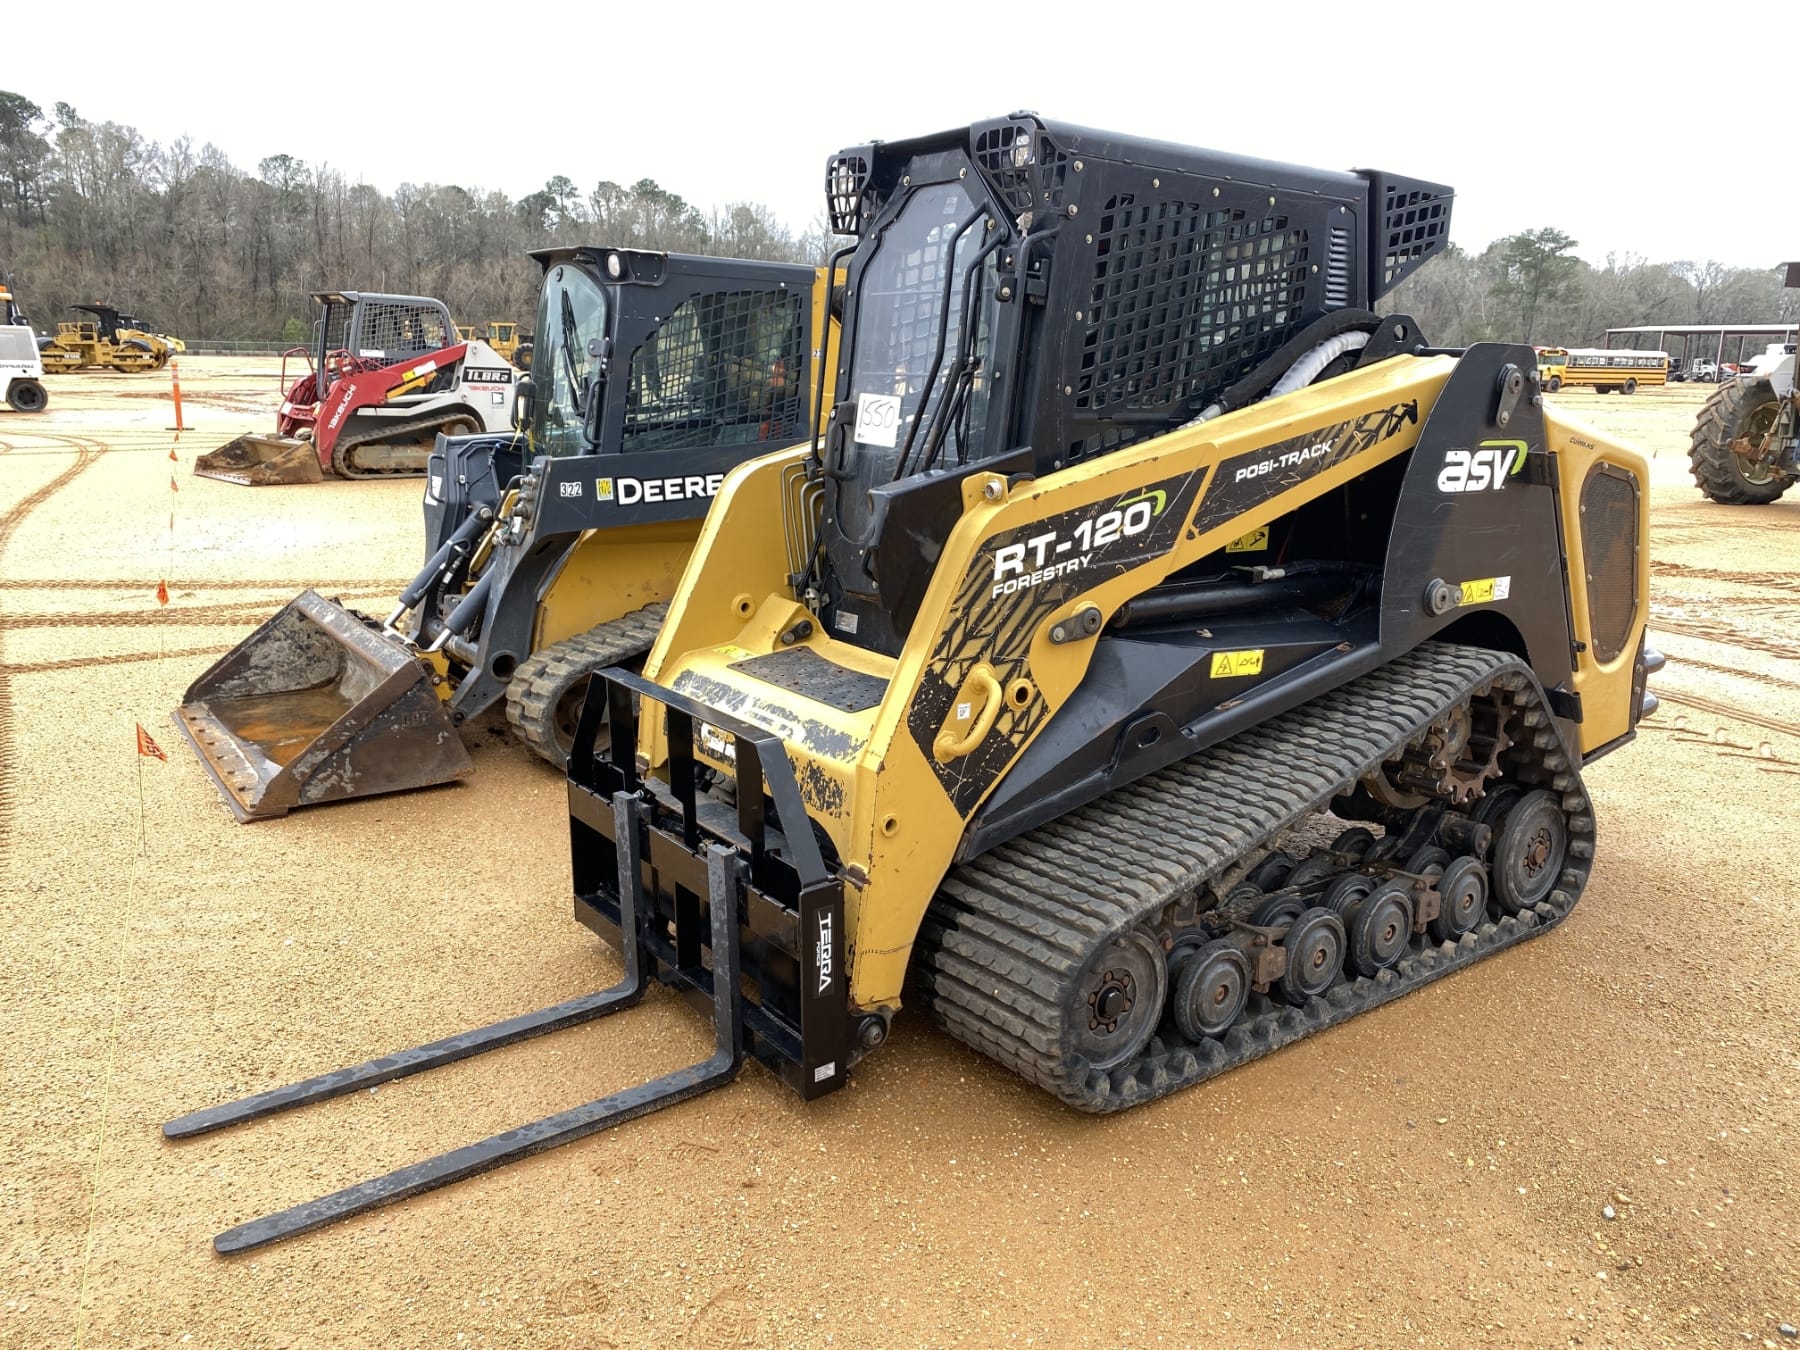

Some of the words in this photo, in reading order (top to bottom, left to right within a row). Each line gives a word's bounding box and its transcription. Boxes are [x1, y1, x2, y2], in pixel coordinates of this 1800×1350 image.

[859, 399, 895, 429] 1550
[1235, 439, 1333, 483] POSI-TRACK
[560, 482, 582, 496] 322
[616, 473, 724, 506] DEERE
[993, 500, 1152, 582] RT-120
[991, 553, 1093, 599] FORESTRY
[819, 912, 832, 993] TERRA
